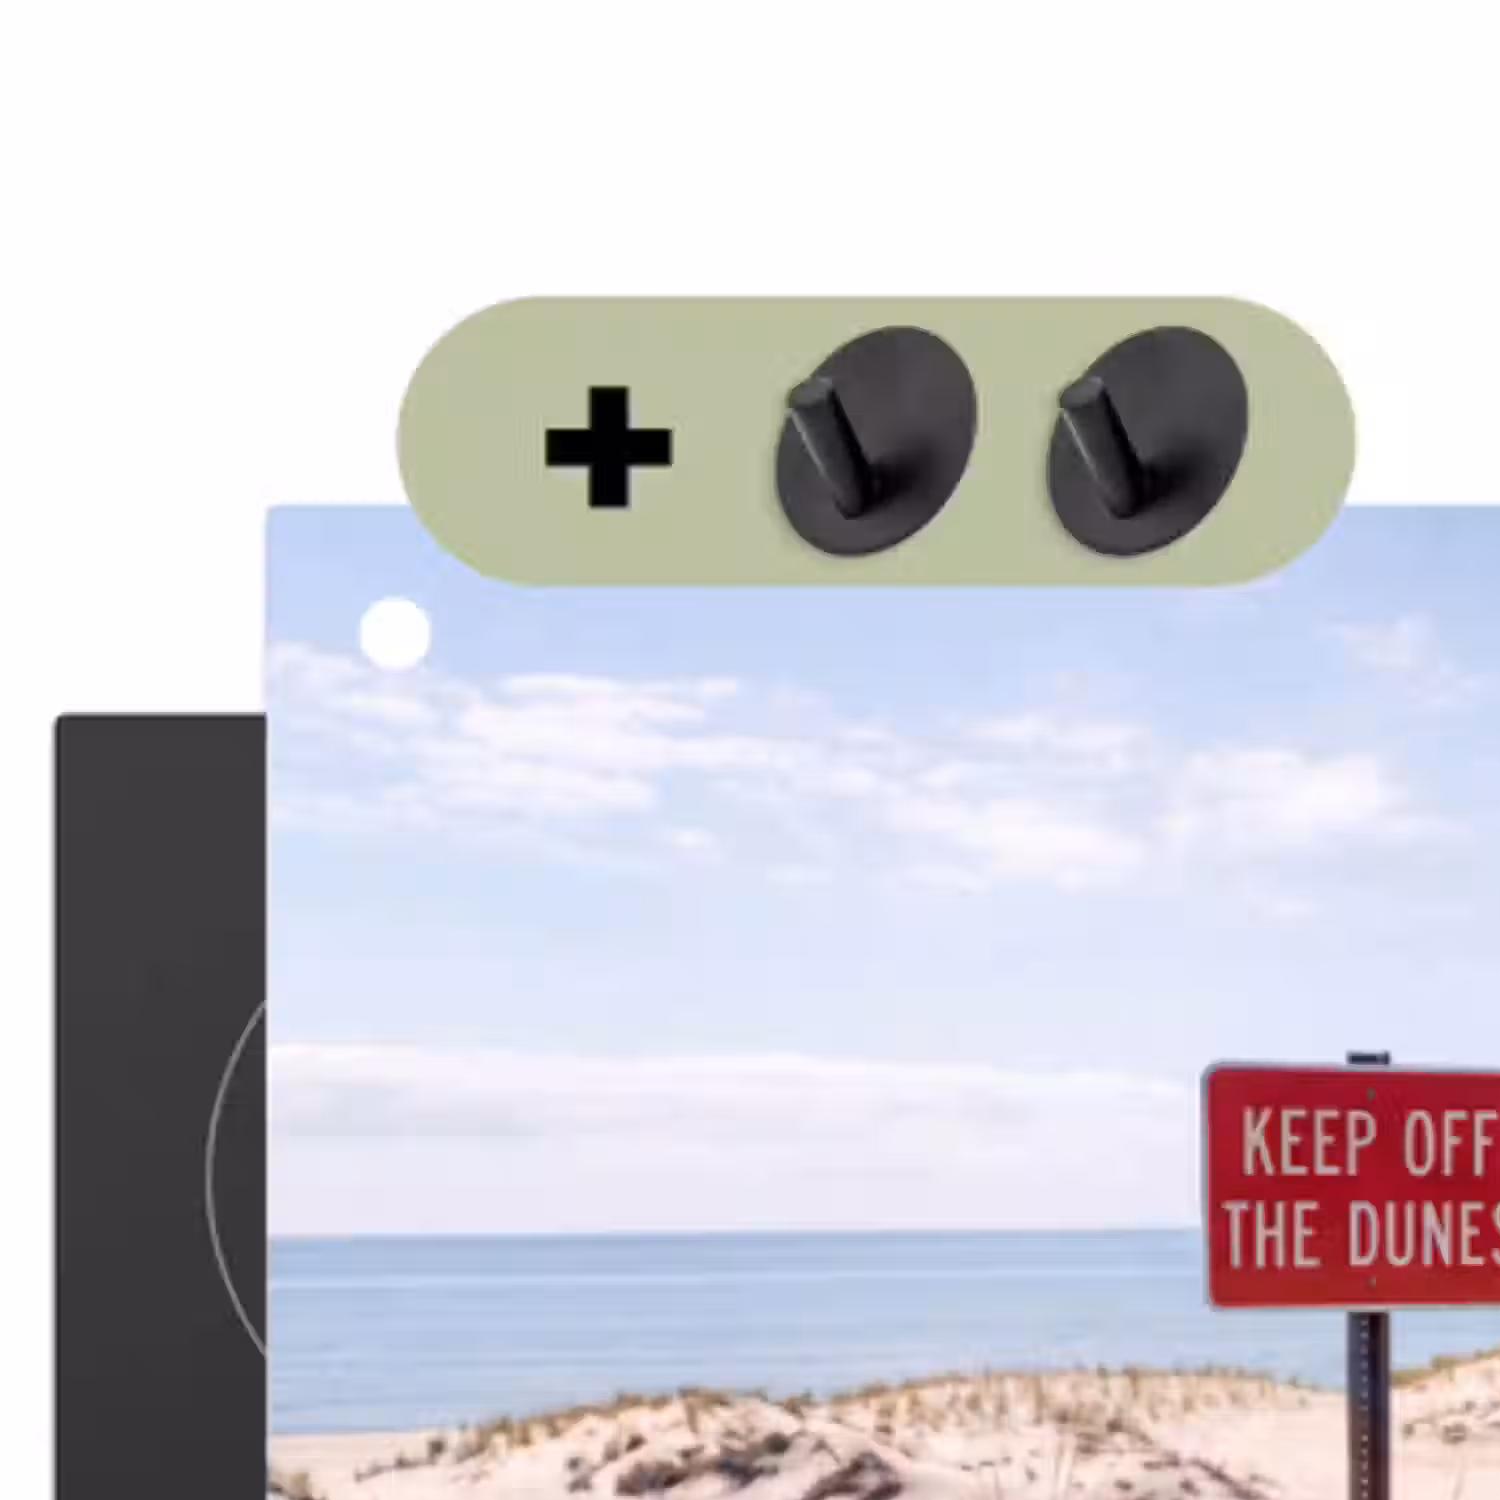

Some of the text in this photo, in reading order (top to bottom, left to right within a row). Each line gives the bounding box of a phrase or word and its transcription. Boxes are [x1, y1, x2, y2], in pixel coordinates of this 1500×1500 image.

[1243, 1106, 1500, 1177] KEEP OFF
[1221, 1200, 1322, 1269] THE
